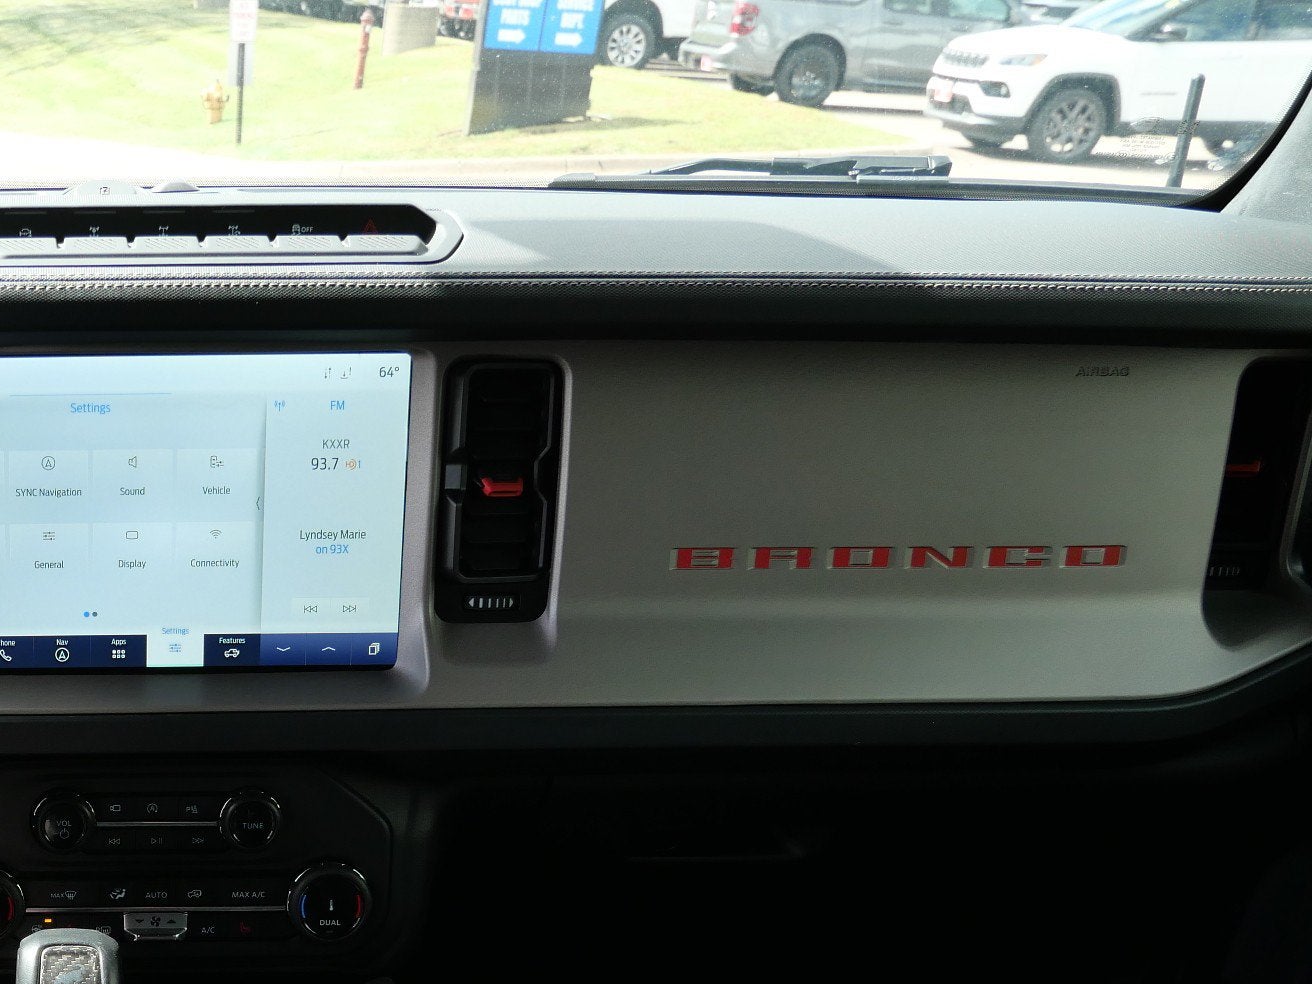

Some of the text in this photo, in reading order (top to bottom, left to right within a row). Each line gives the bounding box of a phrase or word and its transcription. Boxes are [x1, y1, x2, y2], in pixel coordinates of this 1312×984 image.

[1075, 366, 1130, 377] AIRBAG
[71, 402, 110, 415] Settings
[331, 400, 344, 411] FM
[323, 438, 349, 450] KXXR
[312, 457, 338, 471] 93.7
[15, 487, 82, 499] SYNC Navigation
[120, 486, 145, 496] Sound
[203, 485, 230, 495] Vehicle
[299, 529, 366, 541] Lyndsey Marie
[316, 544, 348, 555] on 93X
[669, 546, 1128, 570] BRONCO
[35, 560, 63, 569] General
[119, 559, 146, 570] Display
[191, 558, 239, 569] Connectivity
[162, 627, 190, 637] Settings
[57, 638, 68, 646] Nav
[111, 638, 126, 647] Apps
[219, 636, 245, 644] Features
[242, 822, 265, 830] TUNE
[144, 891, 168, 899] AUTO
[252, 890, 267, 899] A/C
[200, 926, 216, 934] A/C
